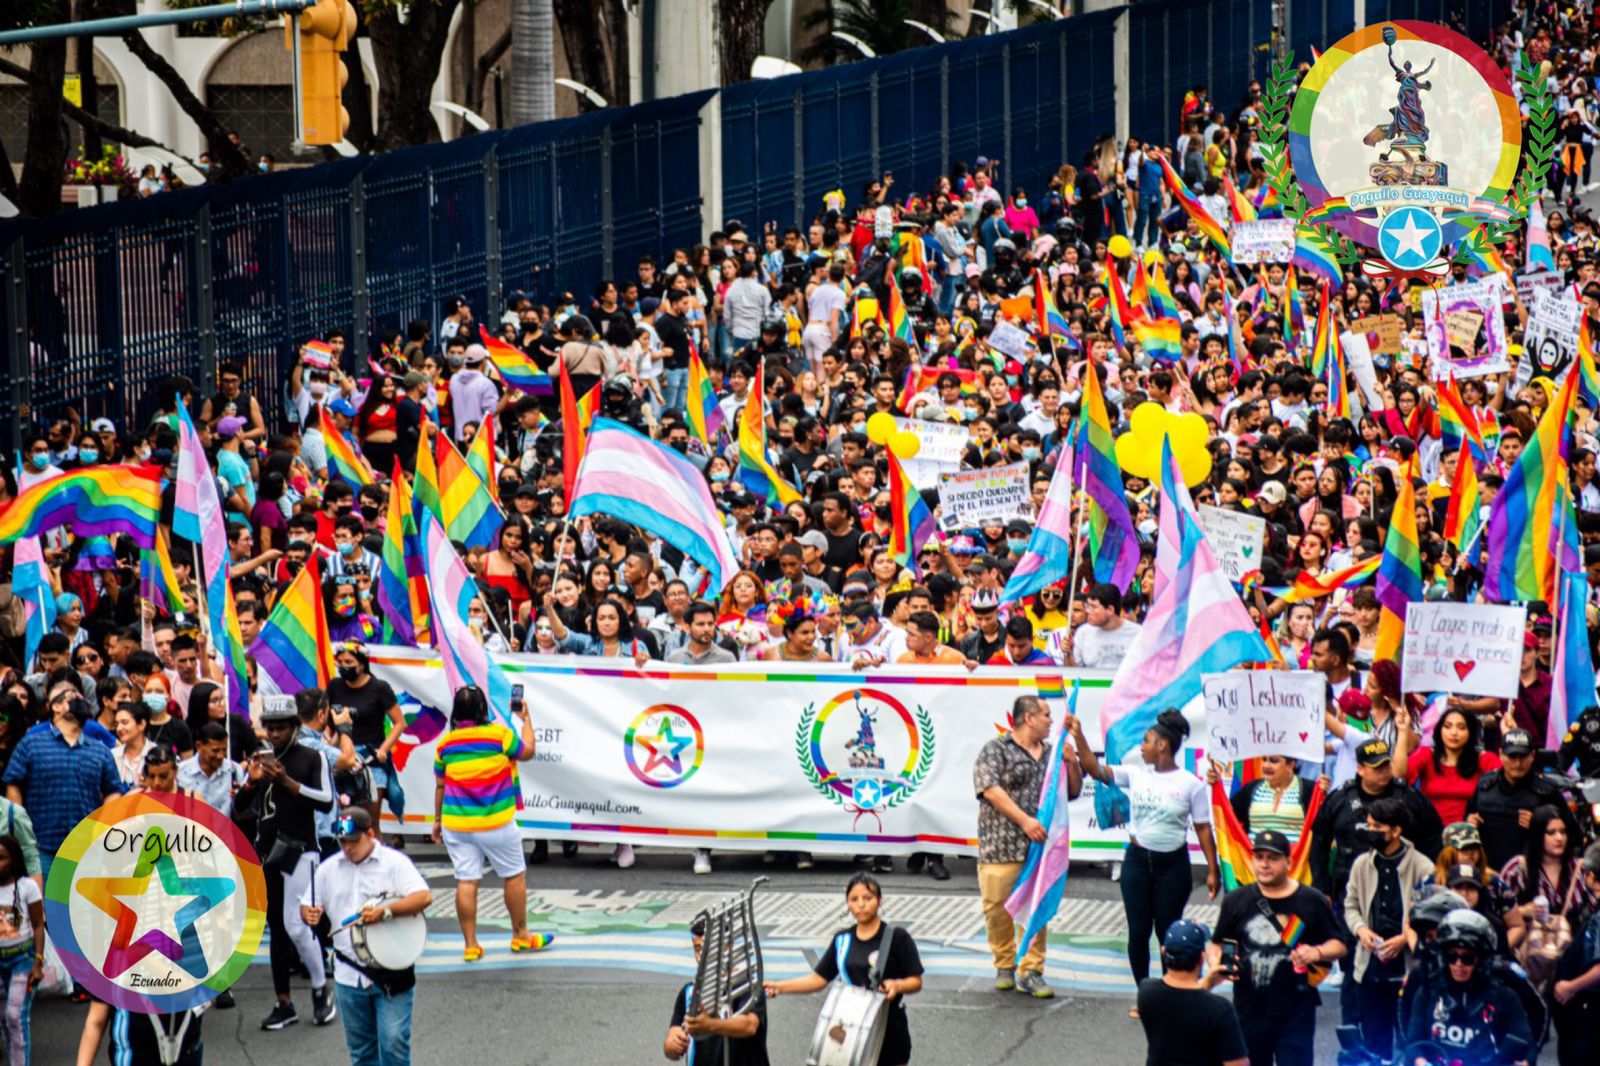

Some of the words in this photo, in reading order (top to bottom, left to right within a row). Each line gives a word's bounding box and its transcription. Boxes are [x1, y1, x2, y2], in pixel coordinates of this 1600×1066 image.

[533, 727, 563, 743] GBT
[534, 750, 563, 763] ador
[523, 794, 642, 815] ulloGuayaquil.com
